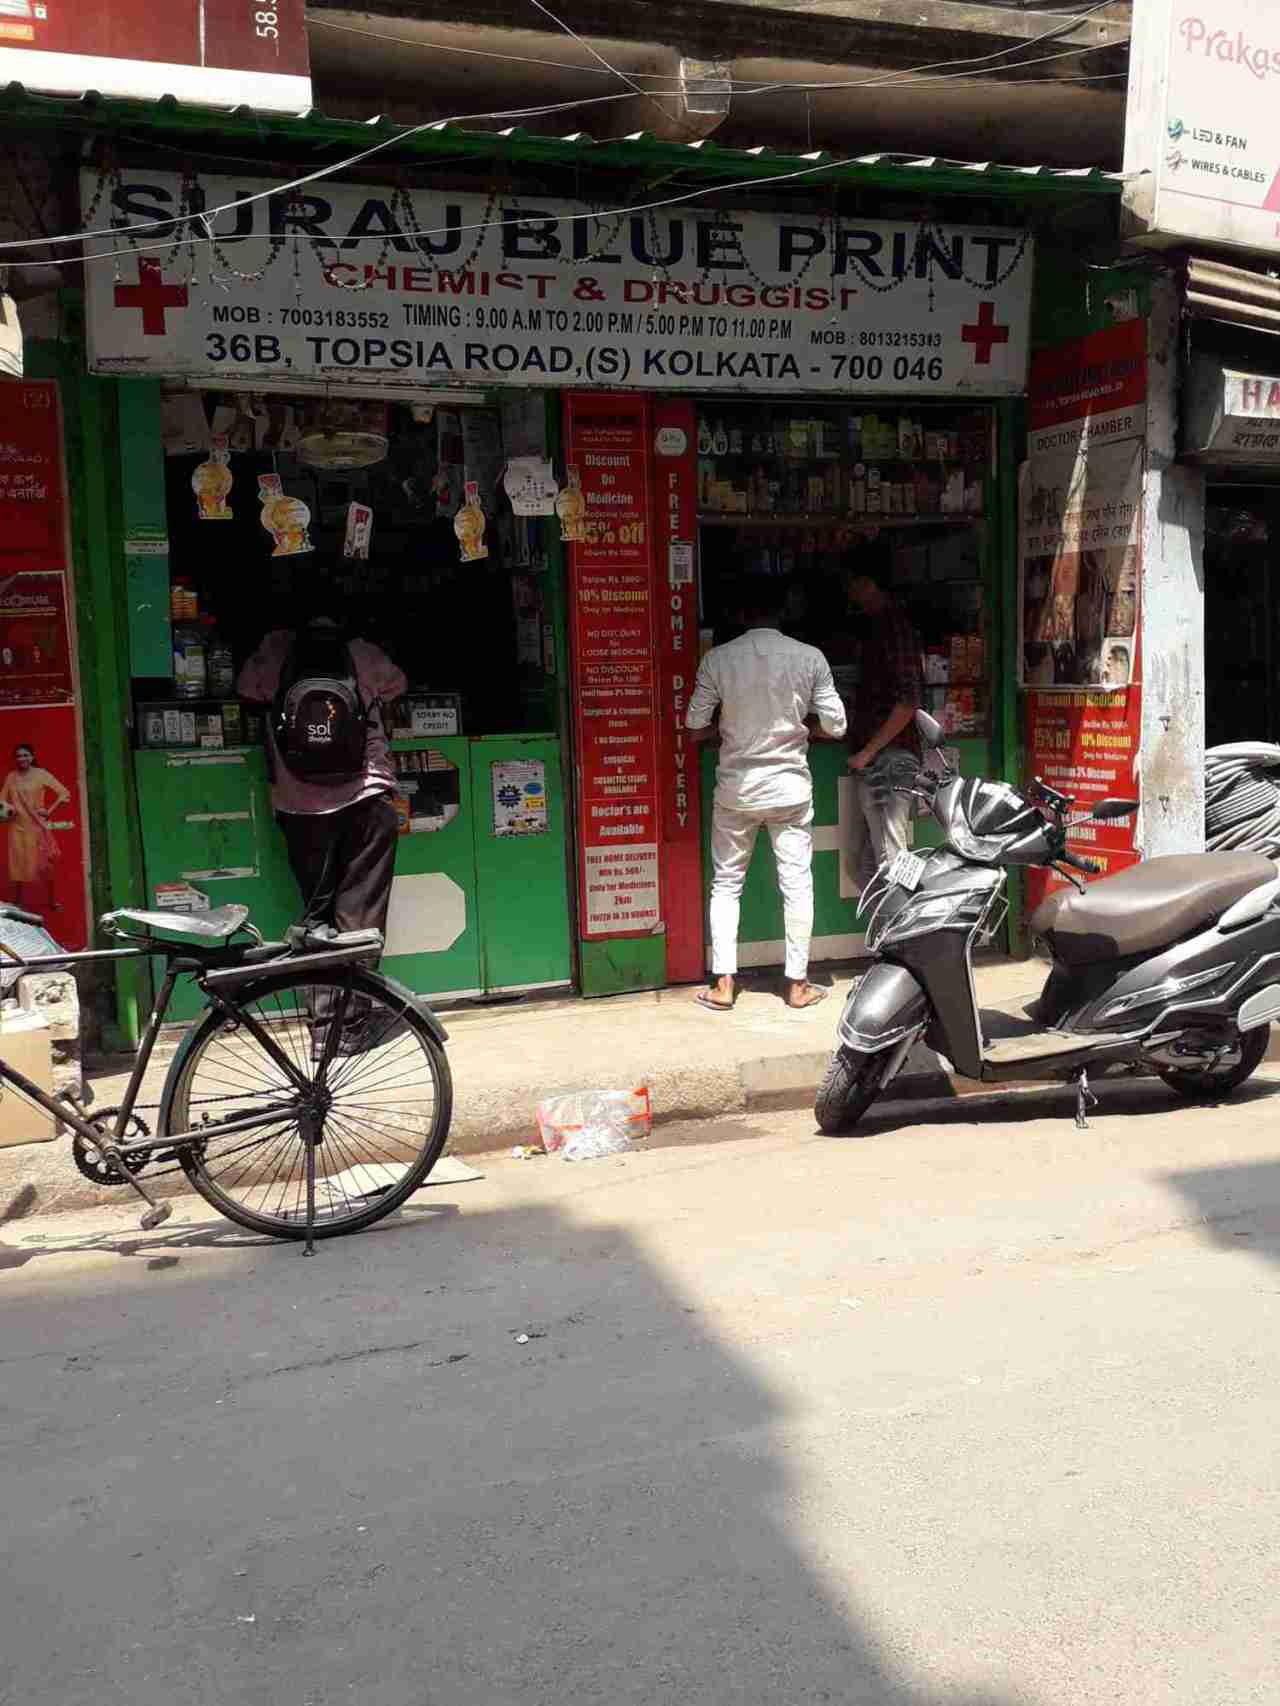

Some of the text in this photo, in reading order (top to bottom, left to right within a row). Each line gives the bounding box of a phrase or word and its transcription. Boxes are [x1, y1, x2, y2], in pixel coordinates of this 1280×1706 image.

[255, 0, 279, 39] 58.
[1192, 127, 1248, 151] LED & FAN
[1191, 158, 1266, 184] WIRES & CABLES
[111, 185, 1017, 283] SURAJ BLUE PRINT
[323, 263, 858, 311] CHEMIST & DRUGGIST
[213, 306, 260, 324] MOB
[279, 309, 390, 329] 7003183552
[402, 303, 461, 327] TIMING
[475, 307, 508, 329] 9.00
[512, 310, 541, 331] A.M
[544, 311, 568, 332] TO
[573, 311, 604, 333] 2.00
[608, 312, 633, 334] P.M
[646, 314, 675, 335] 5.00
[679, 316, 704, 337] P.M
[708, 317, 728, 337] TO
[732, 318, 765, 338] 11.00
[769, 319, 792, 340] P.M
[810, 331, 846, 345] MOB
[206, 333, 292, 368] 36B,
[305, 336, 453, 370] TOPSIA
[643, 349, 801, 379] KOLKATA
[831, 354, 883, 380] 700
[893, 356, 943, 381] 046
[1037, 416, 1132, 451] DOCTOR CHAMBER
[672, 674, 688, 828] DELIVERY
[591, 803, 650, 818] Doctor's are
